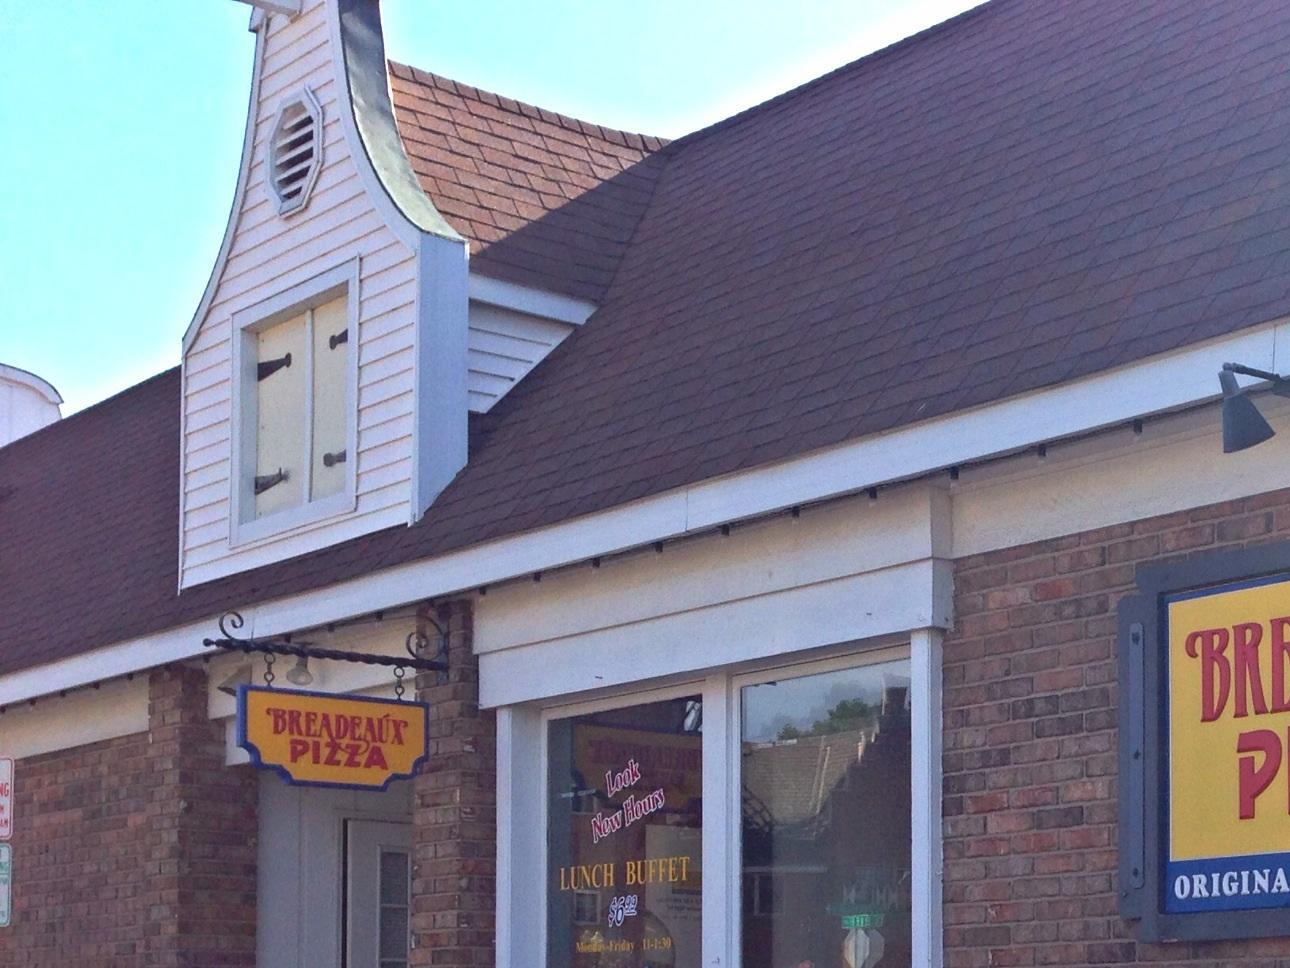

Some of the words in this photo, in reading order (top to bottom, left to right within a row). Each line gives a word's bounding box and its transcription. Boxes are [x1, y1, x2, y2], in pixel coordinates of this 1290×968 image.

[289, 738, 388, 770] PIZZA
[605, 758, 640, 798] Look
[591, 812, 622, 843] New
[623, 788, 665, 827] Hours
[560, 863, 614, 890] LUNCH
[626, 856, 690, 885] BUFFET
